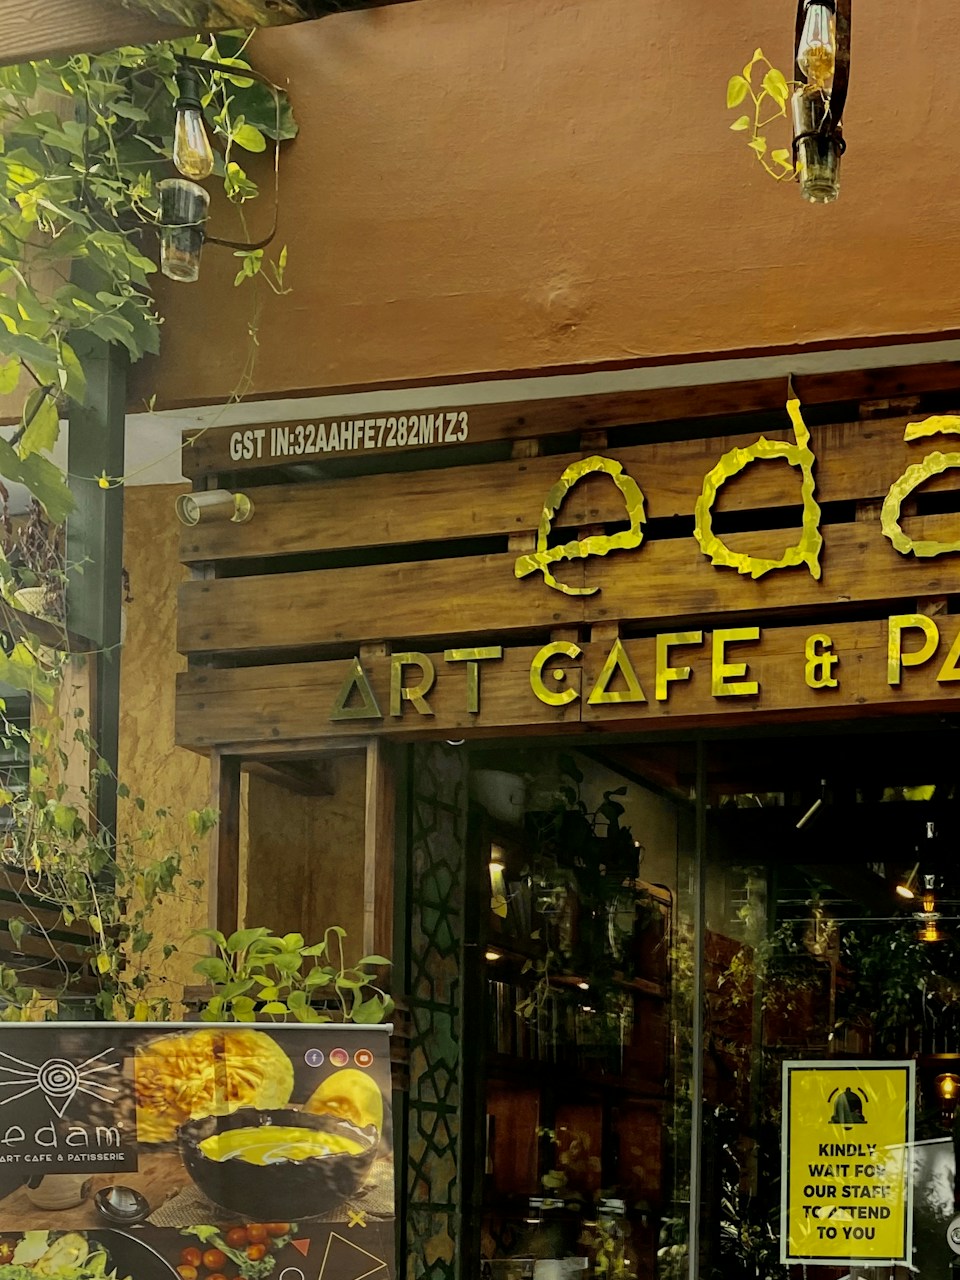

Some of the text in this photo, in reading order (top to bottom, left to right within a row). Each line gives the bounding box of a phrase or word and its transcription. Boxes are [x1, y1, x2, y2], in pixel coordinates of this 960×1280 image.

[230, 429, 265, 461] GST
[329, 644, 502, 721] ART
[530, 626, 761, 707] CAFE
[804, 633, 839, 690] &
[0, 1120, 120, 1147] edam
[819, 1143, 877, 1157] KINDLY
[0, 1153, 125, 1162] ART CAFE & PATISSERIE
[808, 1164, 850, 1177] WAIT
[803, 1184, 891, 1198] OUR STAFF
[817, 1226, 876, 1240] TO YOU
